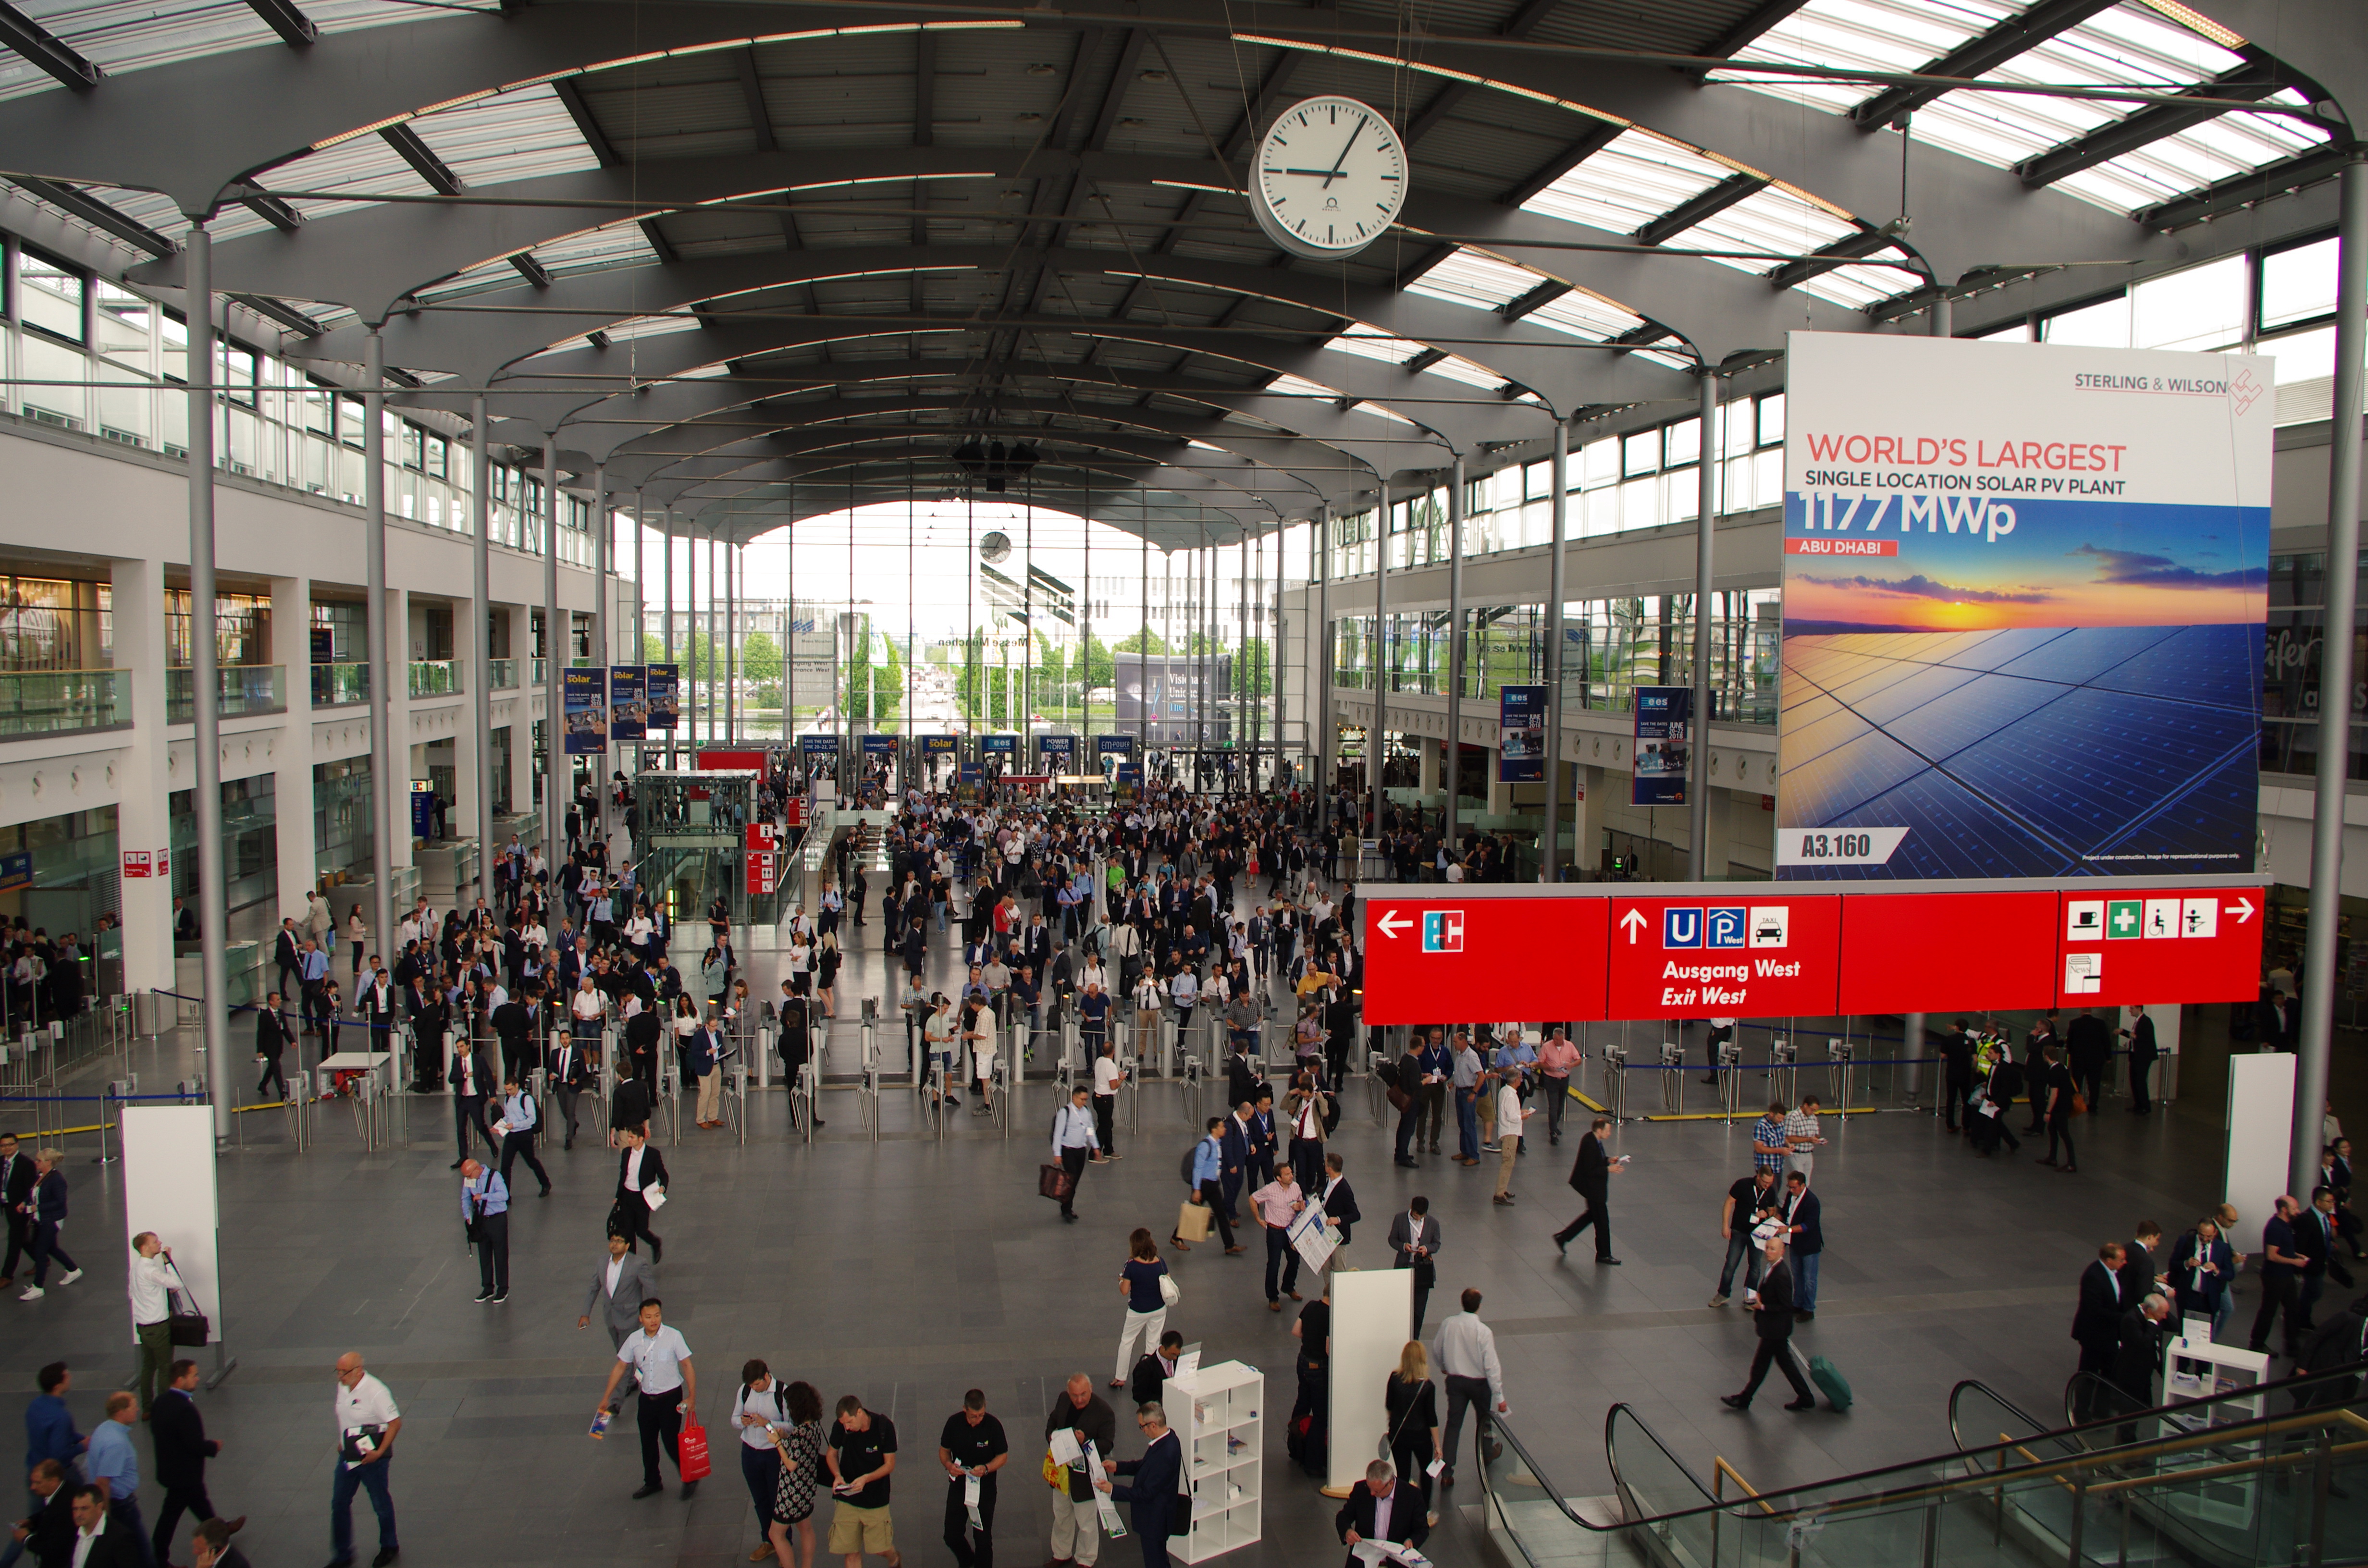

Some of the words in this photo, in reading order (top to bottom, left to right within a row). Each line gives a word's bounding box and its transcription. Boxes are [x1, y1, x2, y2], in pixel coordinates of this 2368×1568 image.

[2075, 373, 2148, 390] STERLING
[2153, 378, 2163, 391] &
[2168, 378, 2227, 394] WILSON
[1807, 433, 1967, 466] WORLD'S
[1977, 440, 2127, 472] LARGEST
[1805, 469, 1872, 487] SINGLE
[1876, 472, 1972, 490] LOCATION
[1976, 475, 2037, 492] SOLAR
[2041, 478, 2065, 493] PV
[2069, 478, 2126, 495] PLANT
[1798, 491, 1892, 531] 1177
[1900, 493, 2017, 543] MWp
[1799, 540, 1831, 553] ABU
[1835, 540, 1881, 555] DHABI
[2264, 629, 2323, 681] äfer
[567, 674, 591, 683] solar
[929, 739, 953, 747] solar
[1801, 833, 1870, 858] A3.160
[1672, 914, 1695, 943] U
[1716, 918, 1734, 944] P
[1724, 936, 1743, 944] West
[1662, 960, 1749, 983] Ausgang
[1755, 959, 1801, 977] West
[2069, 965, 2091, 974] News
[1661, 987, 1697, 1006] Exit
[1702, 986, 1747, 1005] West
